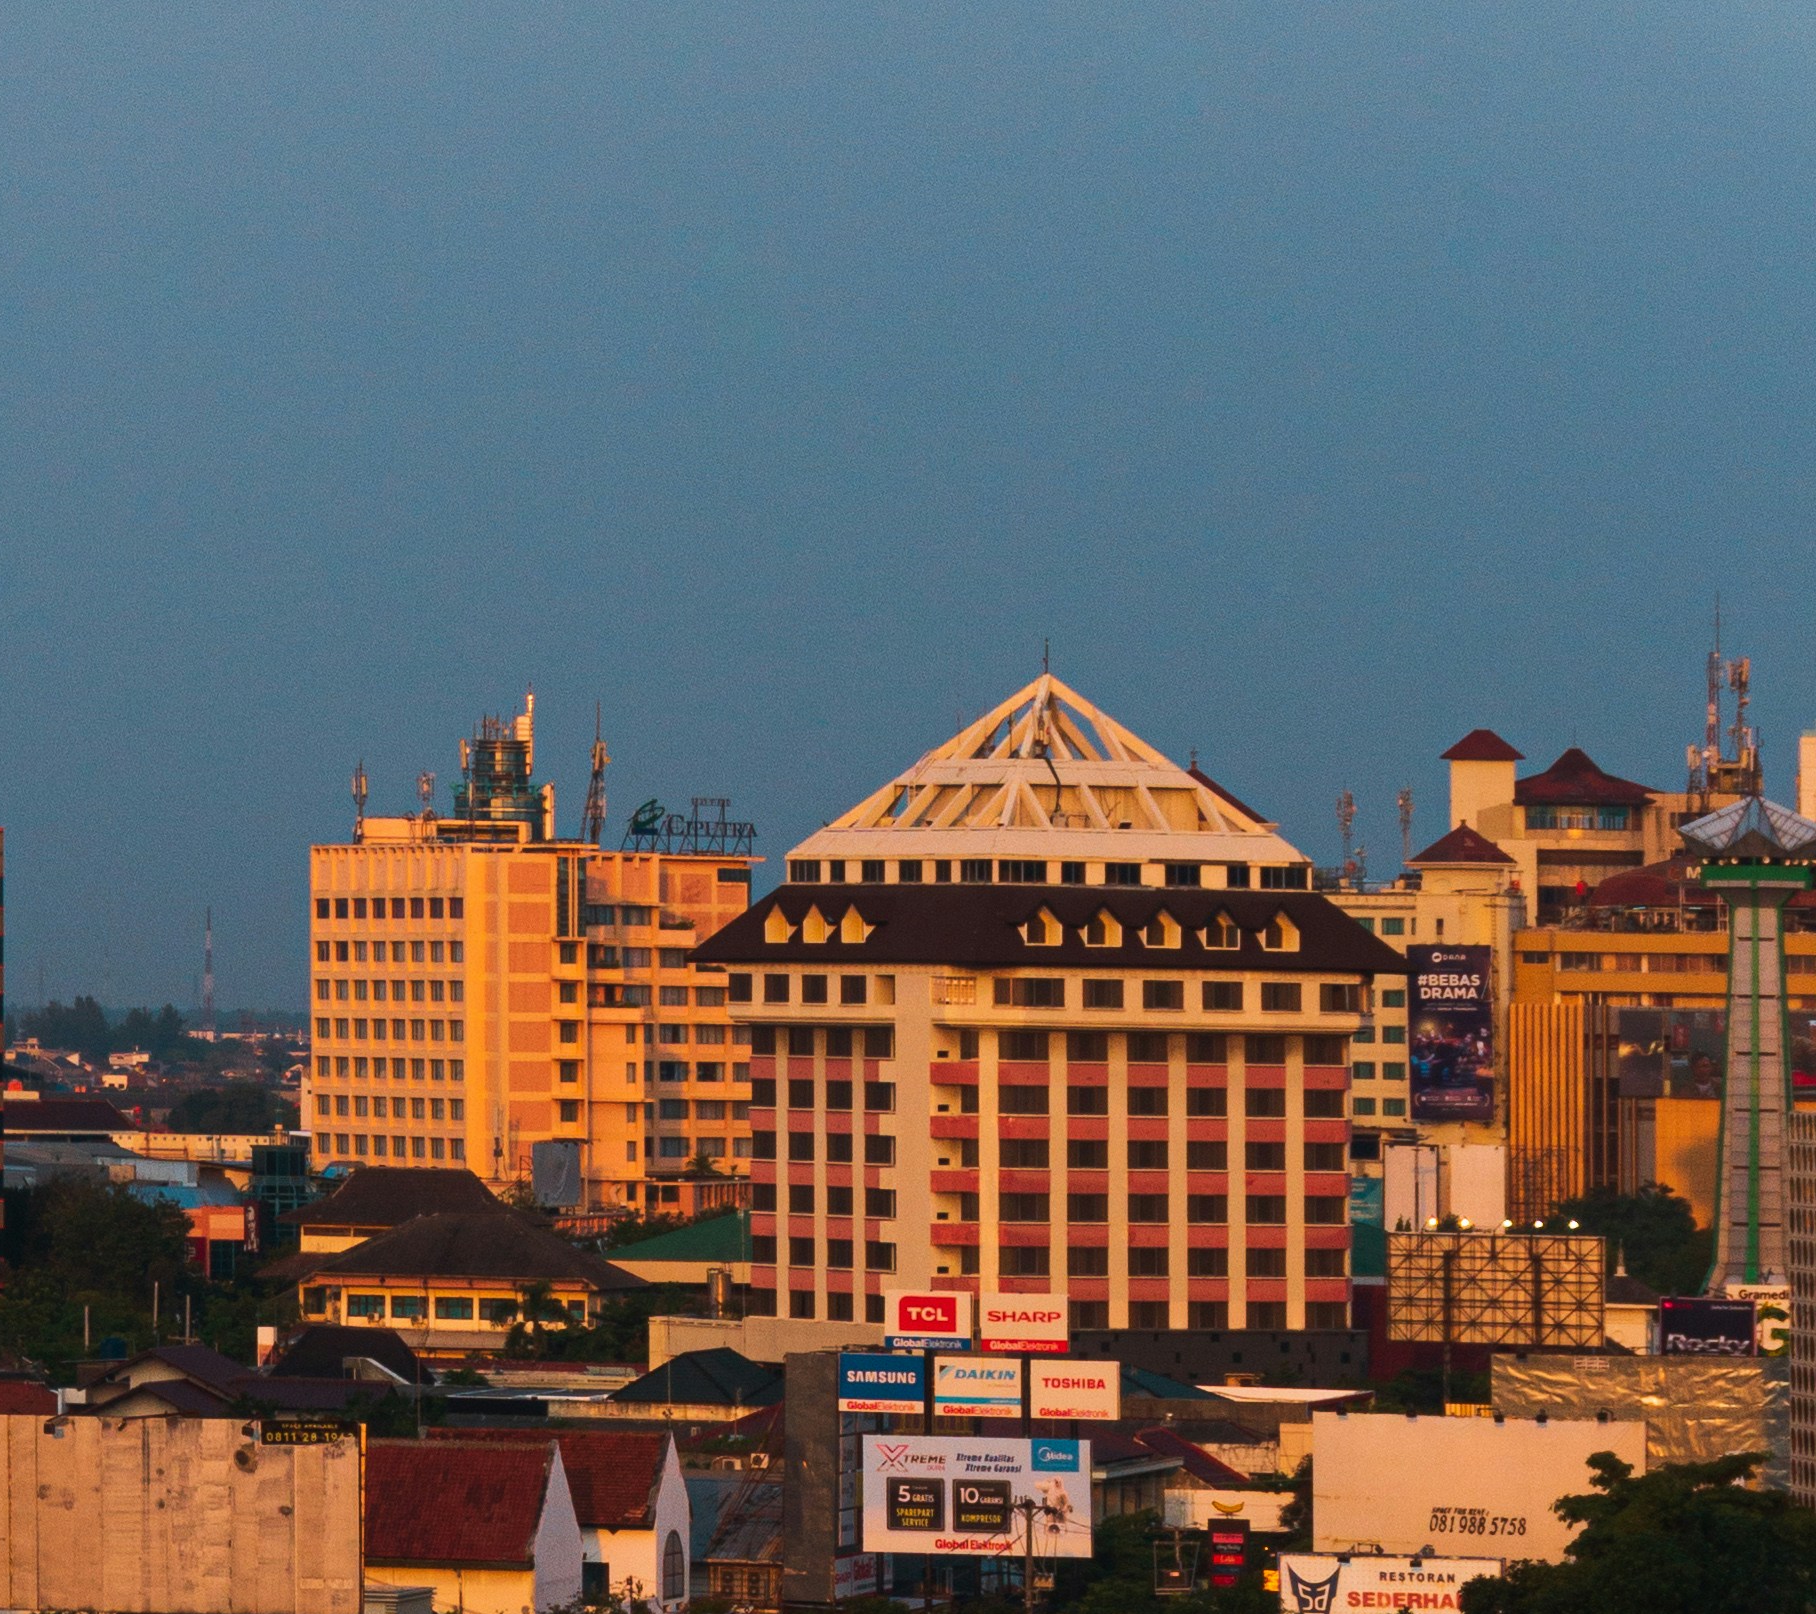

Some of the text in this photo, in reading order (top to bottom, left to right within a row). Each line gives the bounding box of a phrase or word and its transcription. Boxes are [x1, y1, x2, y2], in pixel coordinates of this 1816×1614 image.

[1417, 974, 1481, 987] #BEBAS
[1420, 987, 1478, 1000] DRAMA
[1739, 1289, 1790, 1300] Gramedi
[907, 1307, 949, 1321] TCL
[987, 1311, 1061, 1323] SHARP
[847, 1370, 916, 1384] SAMSUNG
[954, 1369, 1016, 1380] DAIKIN
[1042, 1377, 1106, 1389] TOSHIBA
[266, 1432, 297, 1442] 0811
[898, 1485, 911, 1503] 5
[959, 1487, 980, 1504] 10
[1430, 1515, 1527, 1536] 081 988 5758
[935, 1538, 969, 1550] Global
[1379, 1571, 1456, 1584] RESTORAN
